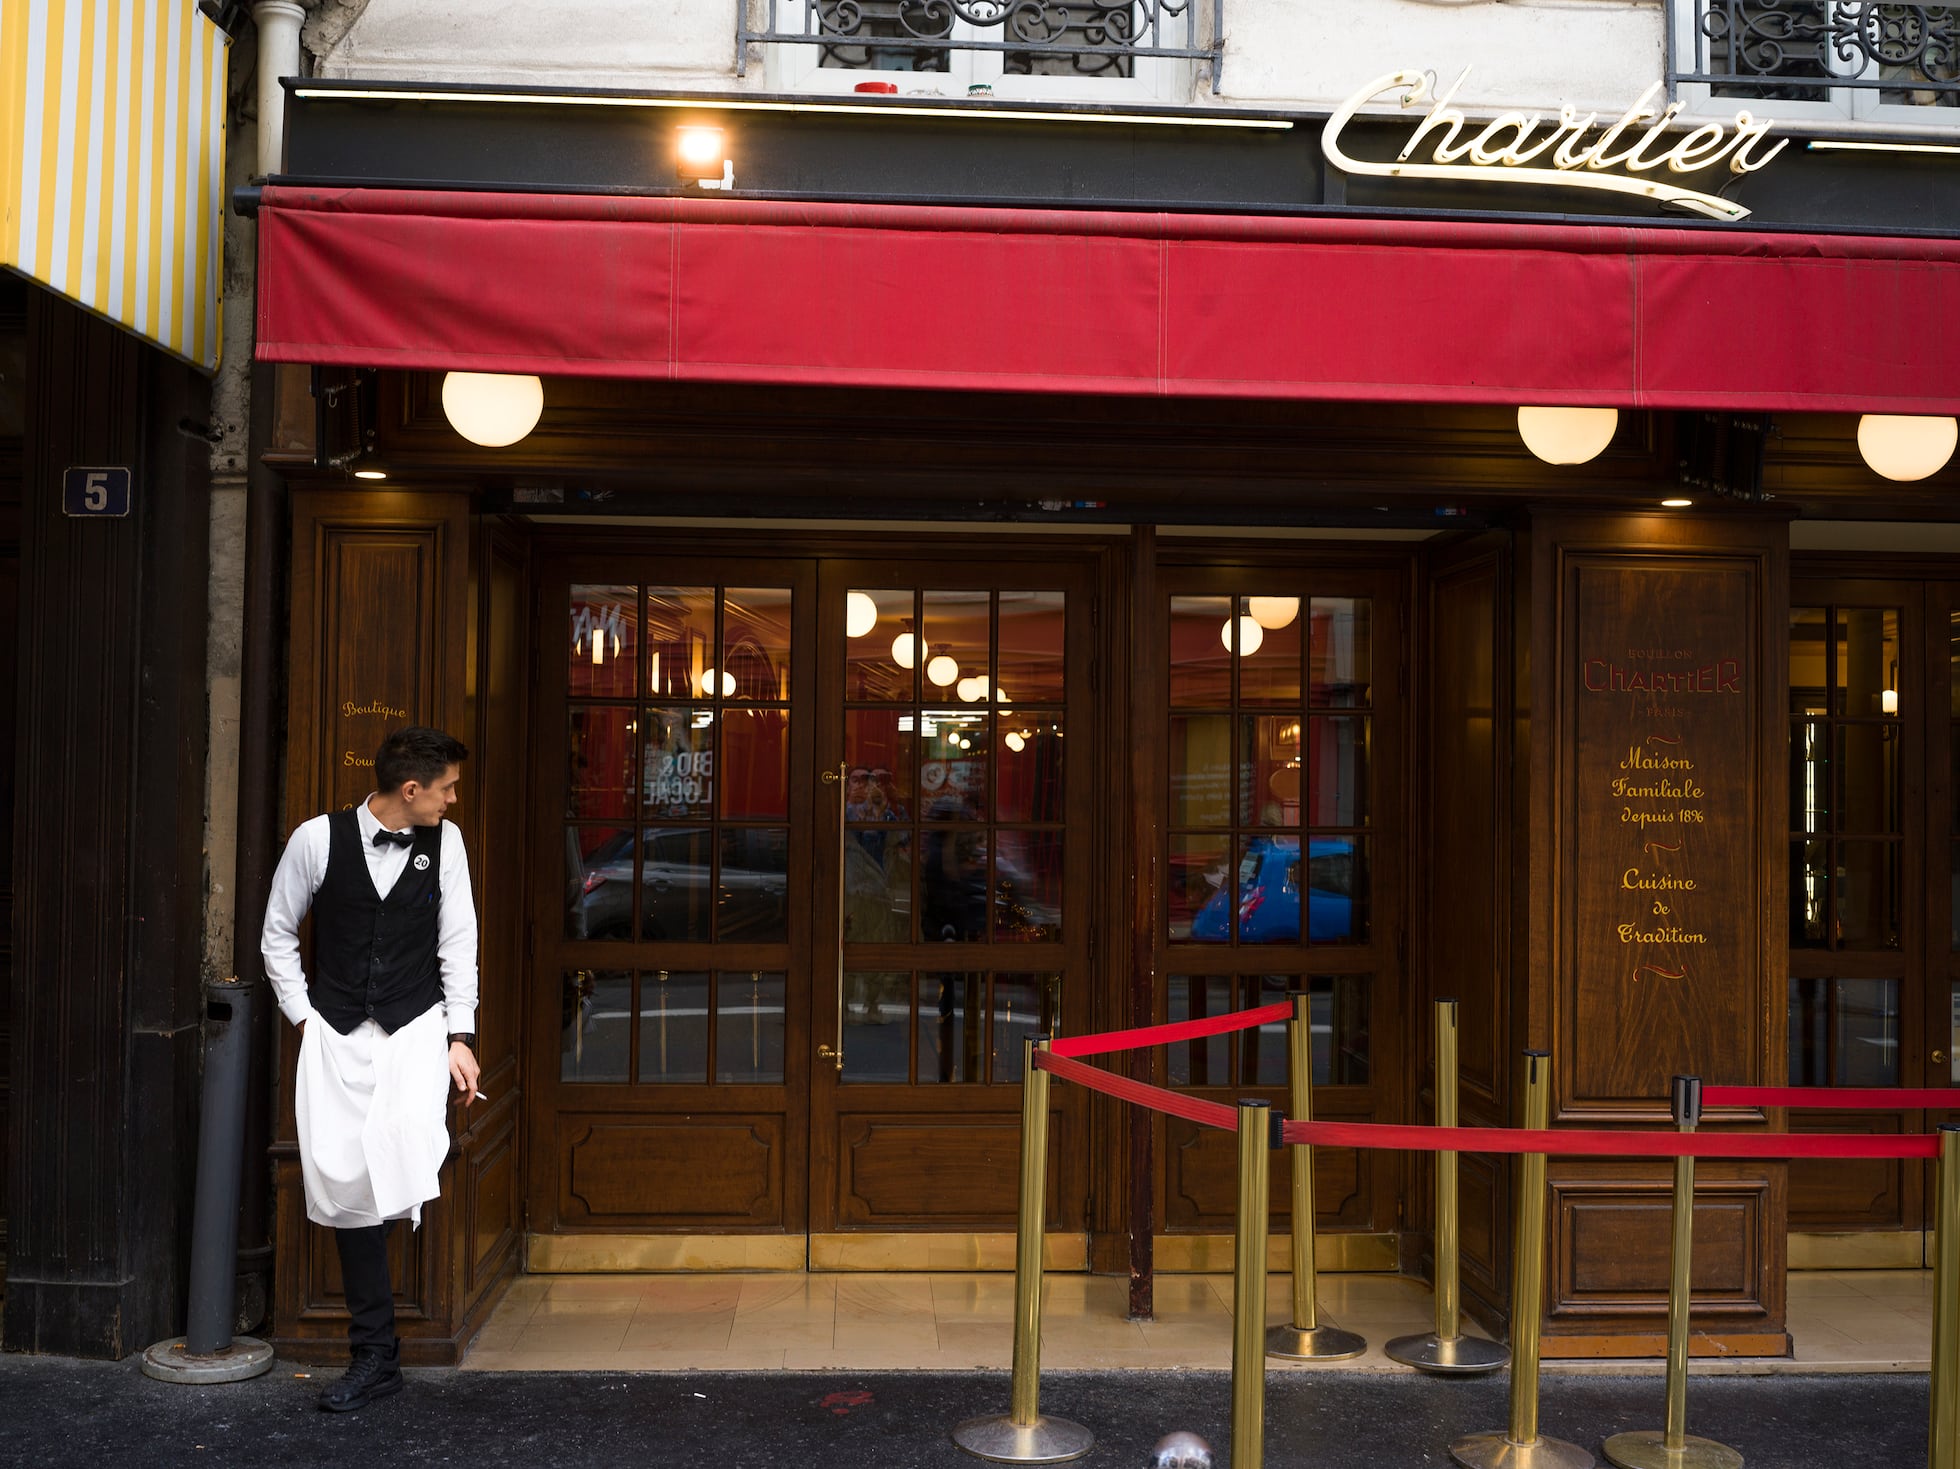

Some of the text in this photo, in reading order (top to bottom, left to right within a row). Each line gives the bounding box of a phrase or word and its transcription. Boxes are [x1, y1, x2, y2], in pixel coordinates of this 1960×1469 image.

[1321, 64, 1789, 221] Chartier
[85, 472, 108, 511] 5
[342, 700, 407, 720] Boutique
[1620, 746, 1694, 770] Maison
[1611, 777, 1705, 799] Familiale
[1621, 807, 1674, 829] depuis
[415, 857, 428, 868] 20
[1621, 868, 1697, 891] Cuisine
[1652, 901, 1670, 915] de
[1616, 922, 1707, 944] Tradition
